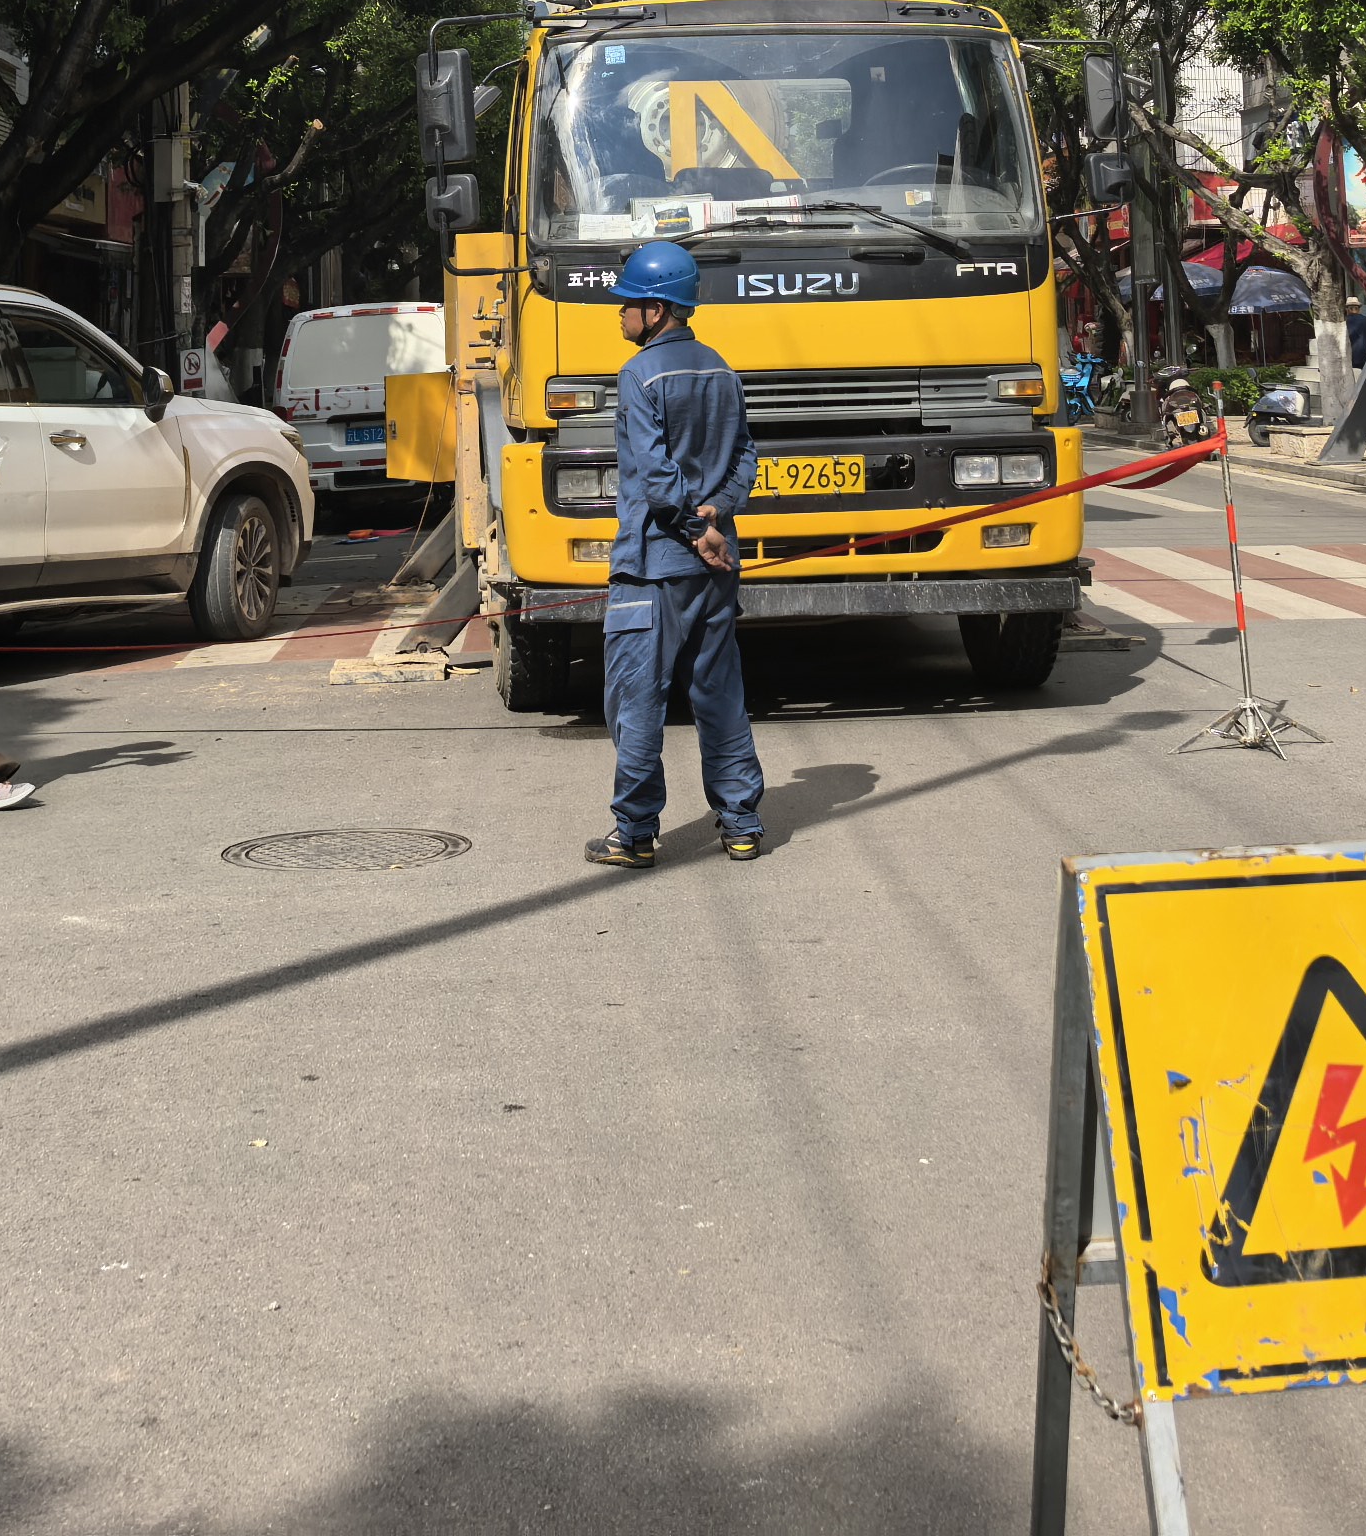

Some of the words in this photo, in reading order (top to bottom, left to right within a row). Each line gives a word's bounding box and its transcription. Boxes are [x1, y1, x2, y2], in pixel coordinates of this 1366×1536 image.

[956, 262, 1018, 277] FTR
[567, 270, 618, 288] 五十铃
[737, 272, 860, 296] ISUZU
[347, 427, 385, 442] 云LST2
